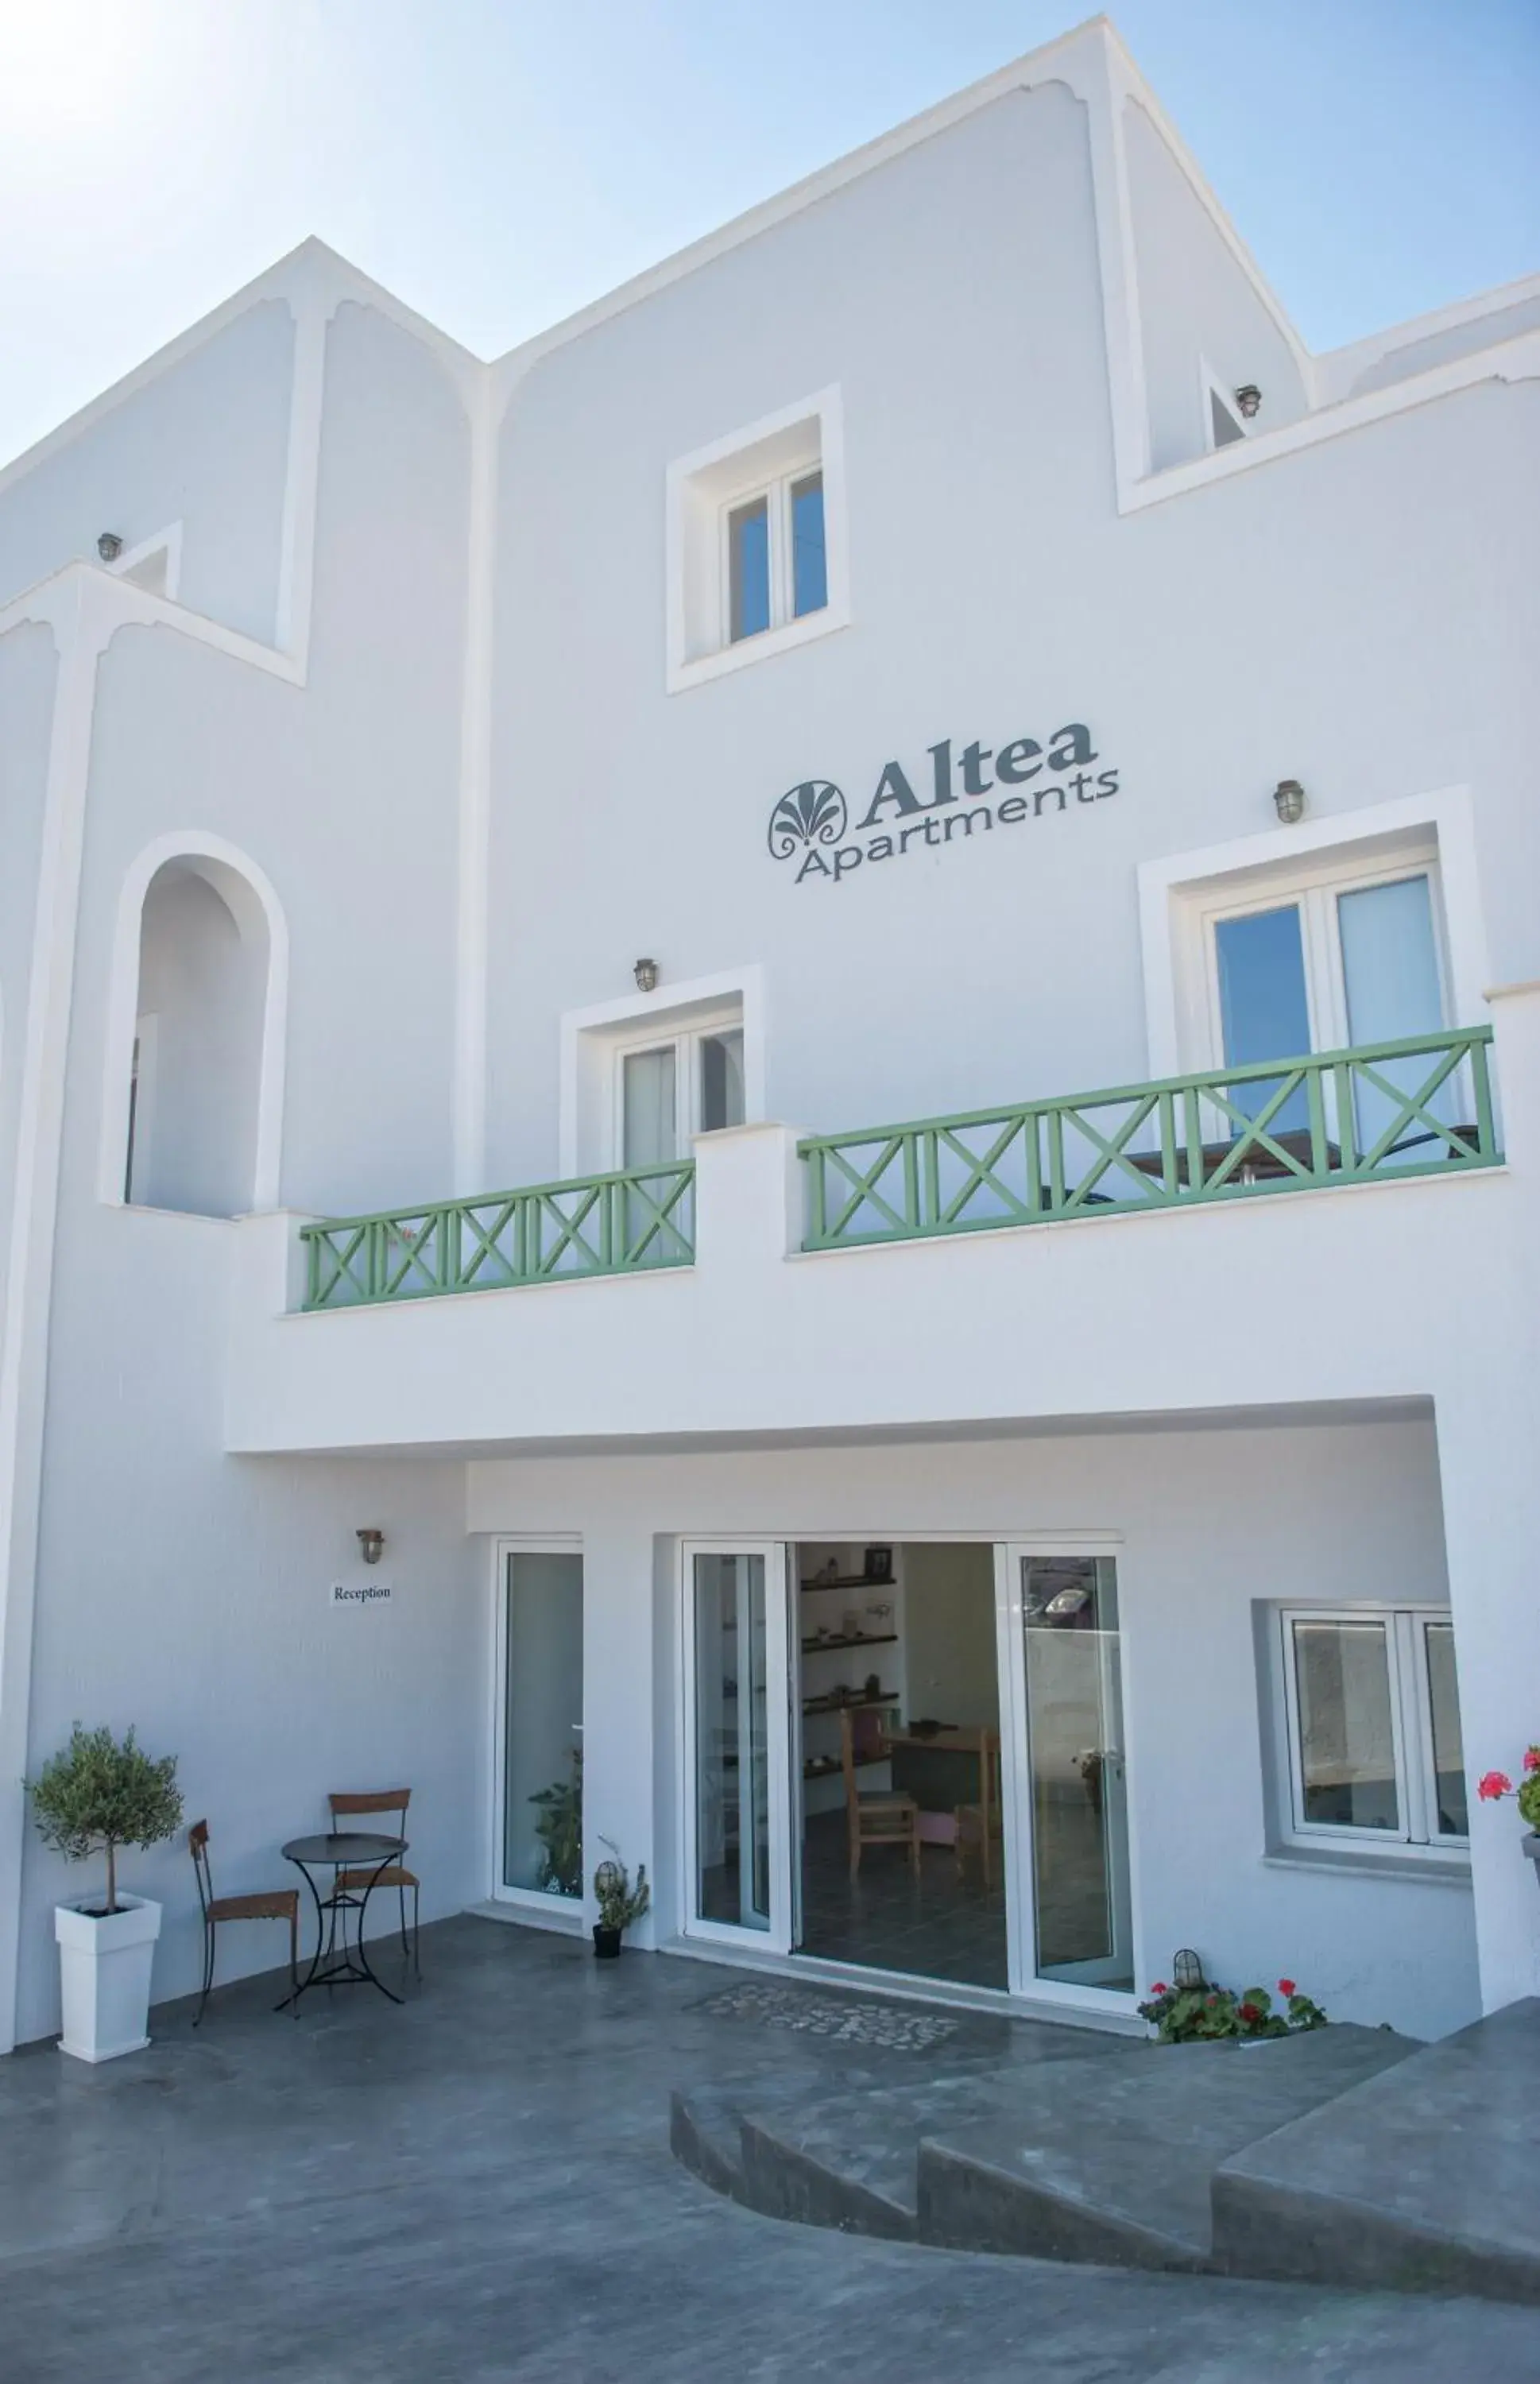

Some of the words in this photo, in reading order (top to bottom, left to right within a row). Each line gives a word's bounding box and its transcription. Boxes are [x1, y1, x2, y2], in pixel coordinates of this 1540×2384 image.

[794, 768, 1120, 884] Apartments
[854, 722, 1100, 830] Altea
[334, 1586, 391, 1604] Reception
